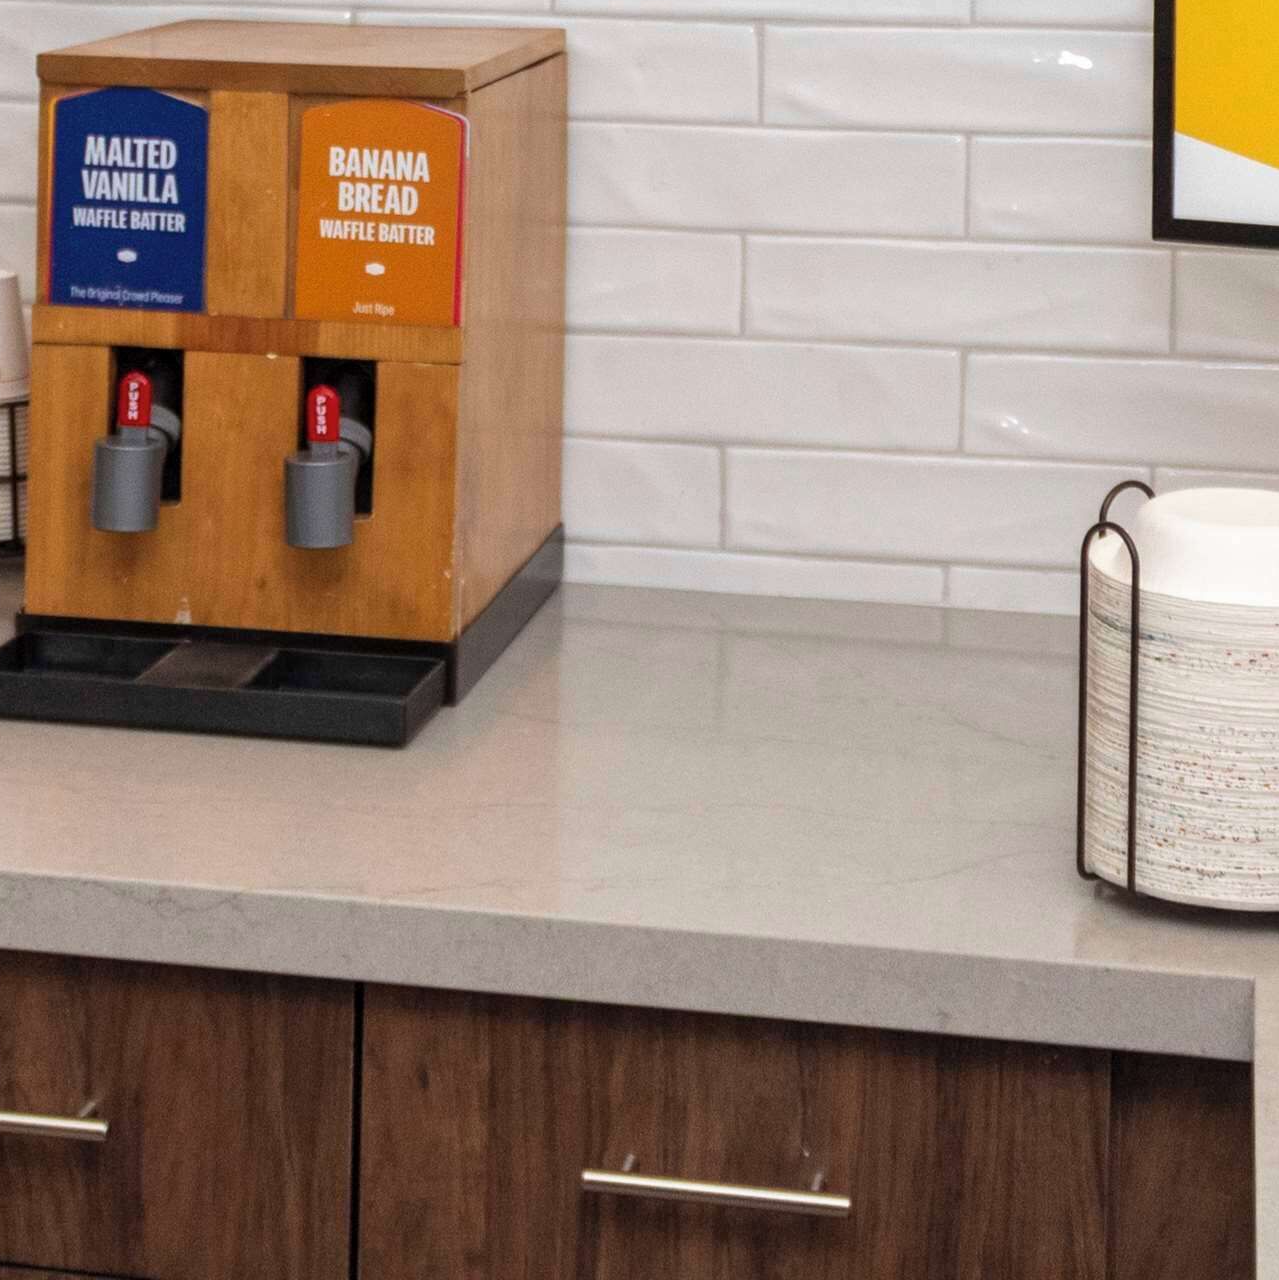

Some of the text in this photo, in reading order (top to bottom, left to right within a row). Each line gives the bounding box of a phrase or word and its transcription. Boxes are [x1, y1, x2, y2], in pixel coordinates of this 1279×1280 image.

[84, 135, 177, 170] MALTED
[328, 146, 430, 183] BANANA
[81, 169, 179, 204] VANILLA
[338, 181, 418, 216] BREAD
[72, 207, 186, 233] WAFFLE BATTER
[320, 219, 436, 246] WAFFLE BATTER
[352, 302, 396, 317] Just Ripe
[128, 381, 139, 420] PUSH
[316, 395, 327, 435] PUSH
